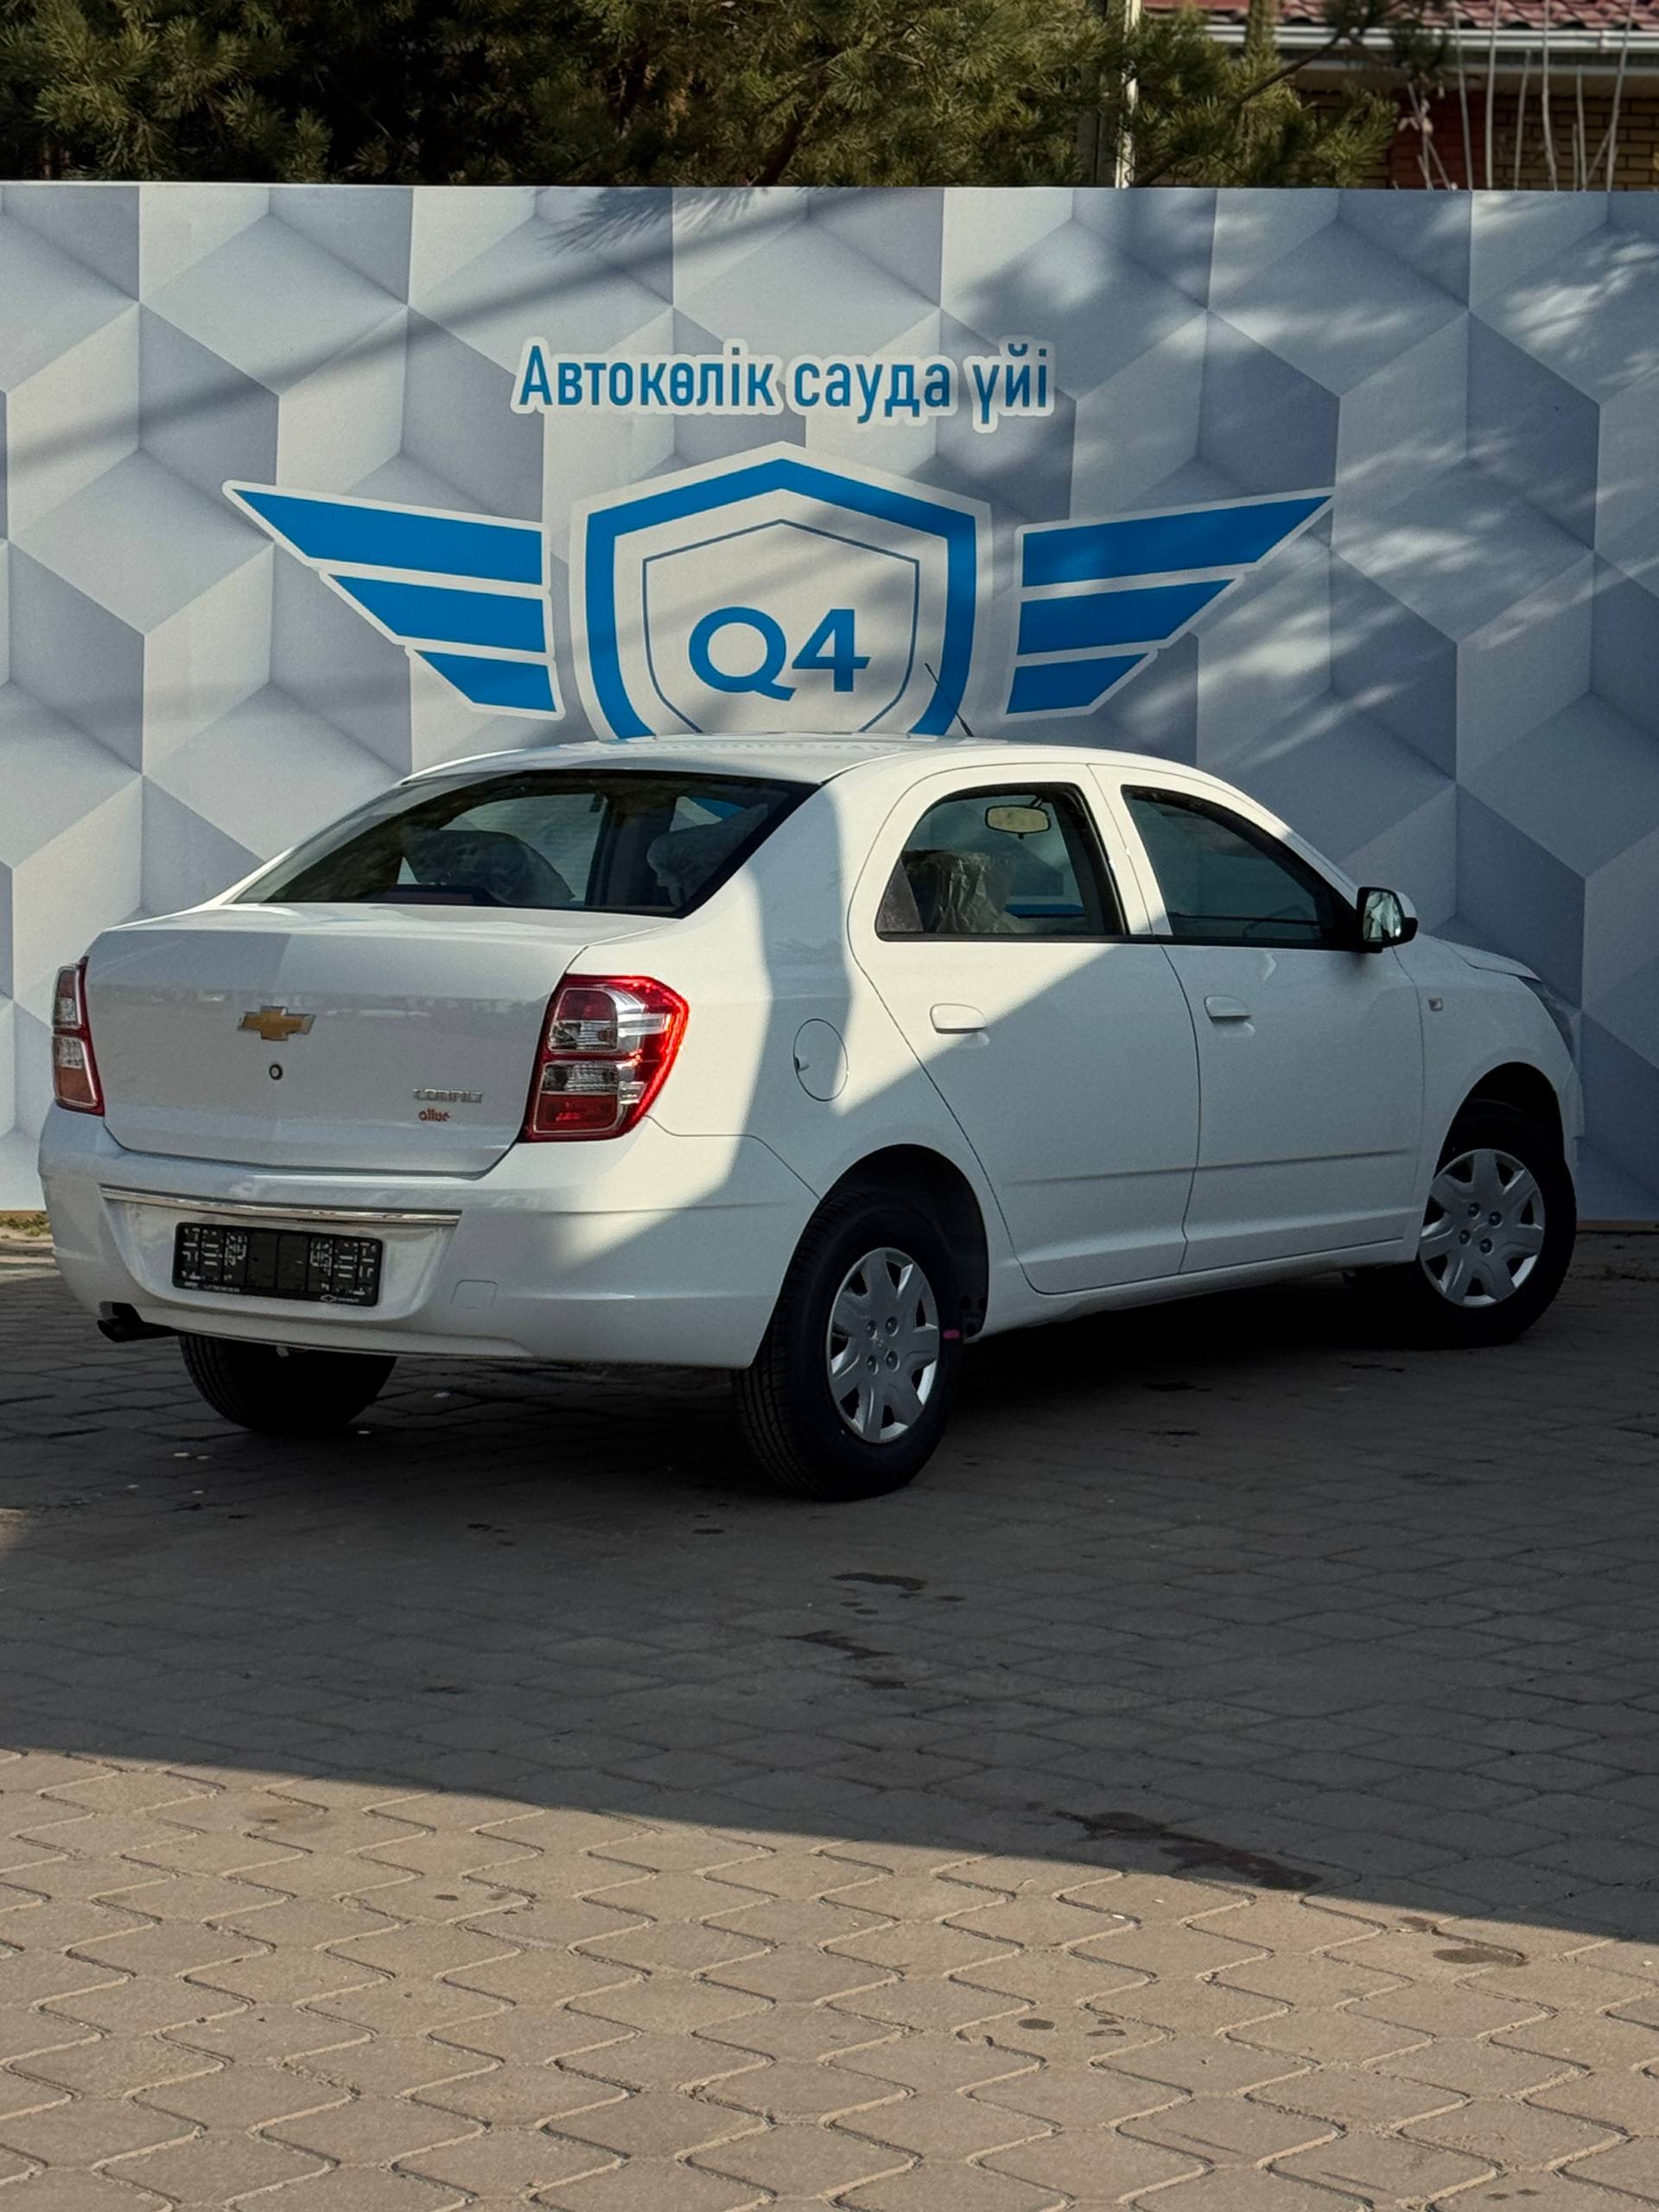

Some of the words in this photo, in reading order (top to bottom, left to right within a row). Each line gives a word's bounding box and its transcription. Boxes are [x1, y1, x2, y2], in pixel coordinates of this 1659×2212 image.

[518, 345, 775, 408] Автокөлік
[793, 361, 952, 424] сауда
[972, 342, 1048, 425] үйі
[688, 606, 872, 702] Q4
